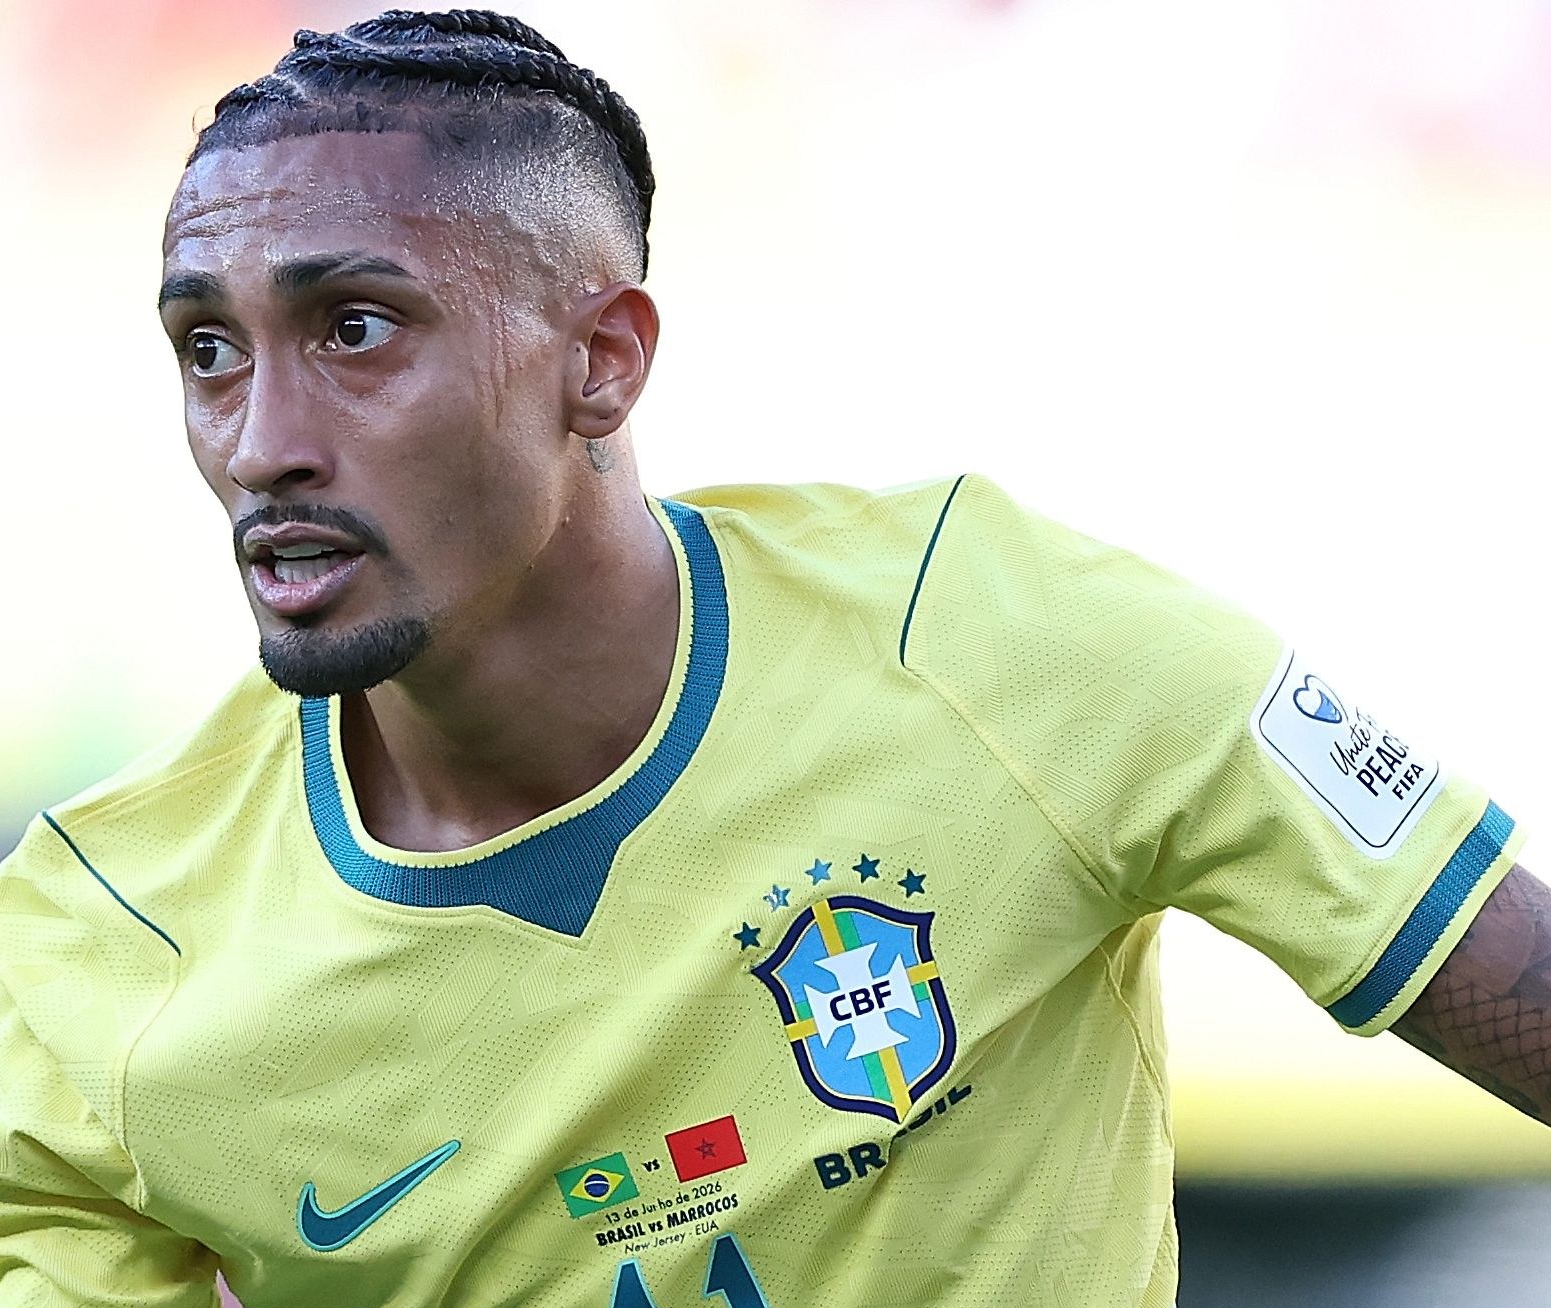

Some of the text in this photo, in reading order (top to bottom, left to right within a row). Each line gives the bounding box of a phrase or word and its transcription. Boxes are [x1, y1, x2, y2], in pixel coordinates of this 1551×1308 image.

[1330, 723, 1371, 776] Unite
[1356, 729, 1409, 797] PEAC
[1391, 763, 1425, 801] FIFA
[830, 979, 892, 1021] CBF
[596, 1222, 646, 1247] BRASIL
[666, 1193, 739, 1229] MARROCOS
[605, 1212, 621, 1224] 13
[624, 1207, 639, 1219] de
[676, 1191, 690, 1204] de
[692, 1181, 722, 1199] 2026
[624, 1242, 650, 1255] New
[653, 1232, 686, 1248] Jersey
[695, 1220, 719, 1236] EUA
